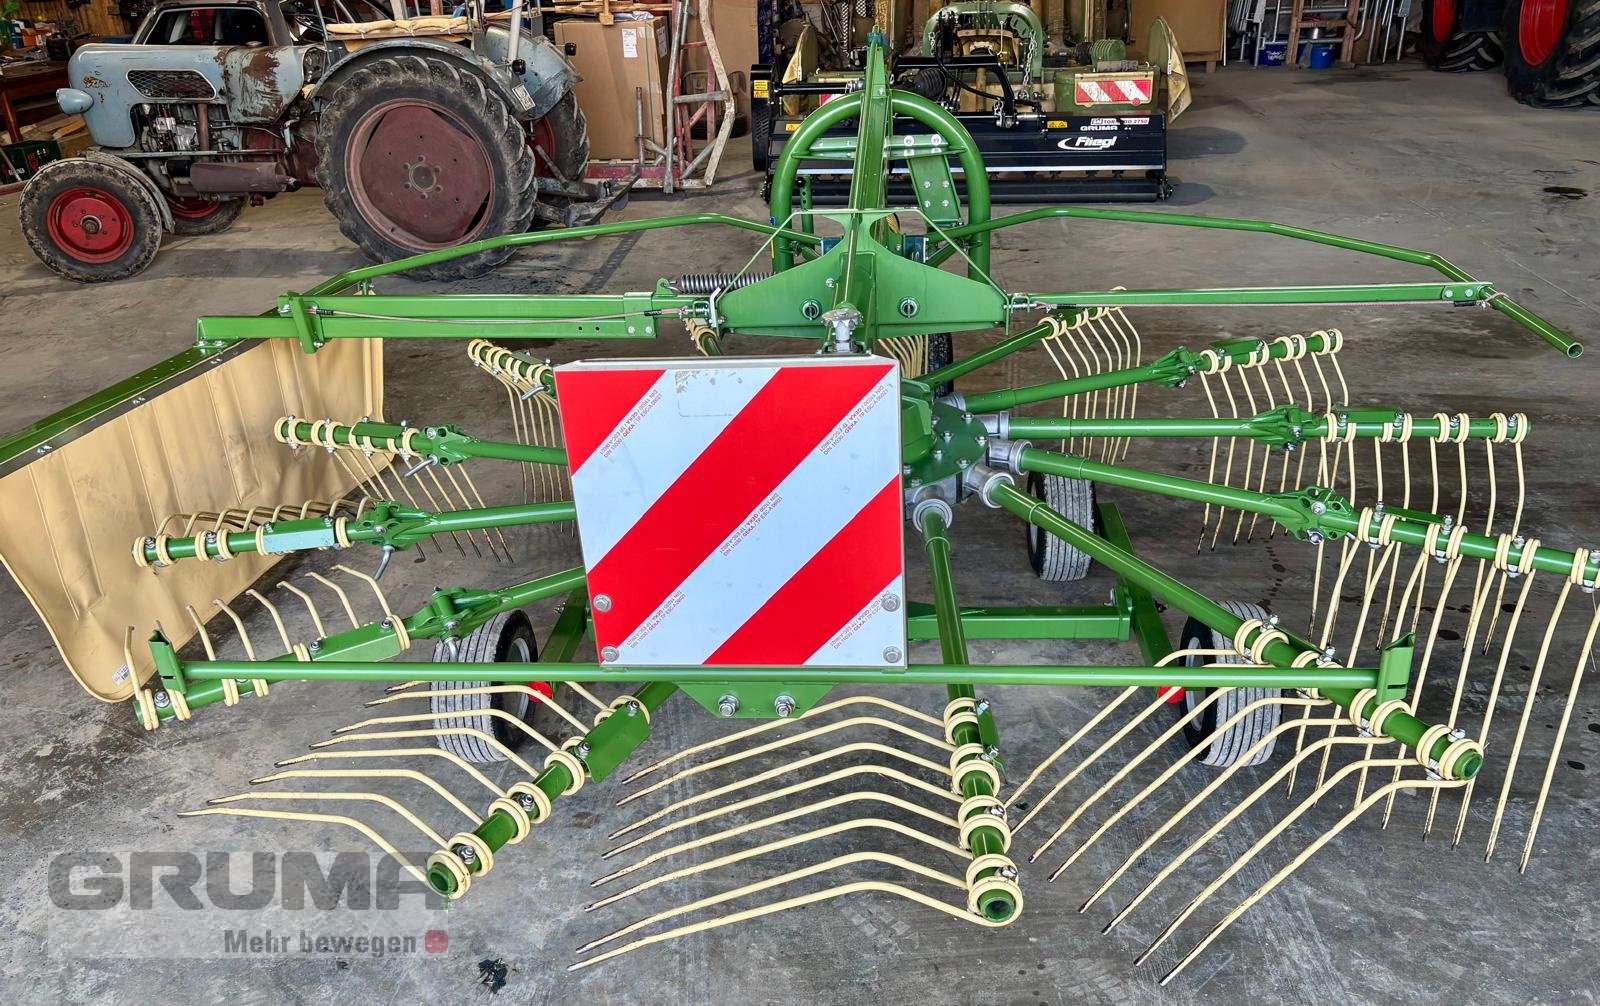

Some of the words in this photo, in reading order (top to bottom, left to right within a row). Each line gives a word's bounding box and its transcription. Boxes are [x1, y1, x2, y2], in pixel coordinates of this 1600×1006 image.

[1075, 136, 1117, 148] Fliegl
[626, 412, 639, 425] GEKA
[849, 408, 863, 421] GEKA
[622, 424, 635, 437] GEKA
[844, 420, 858, 434] GEKA
[746, 514, 759, 527] GEKA
[742, 525, 754, 537] GEKA
[652, 609, 664, 621] GEKA
[648, 620, 660, 631] GEKA
